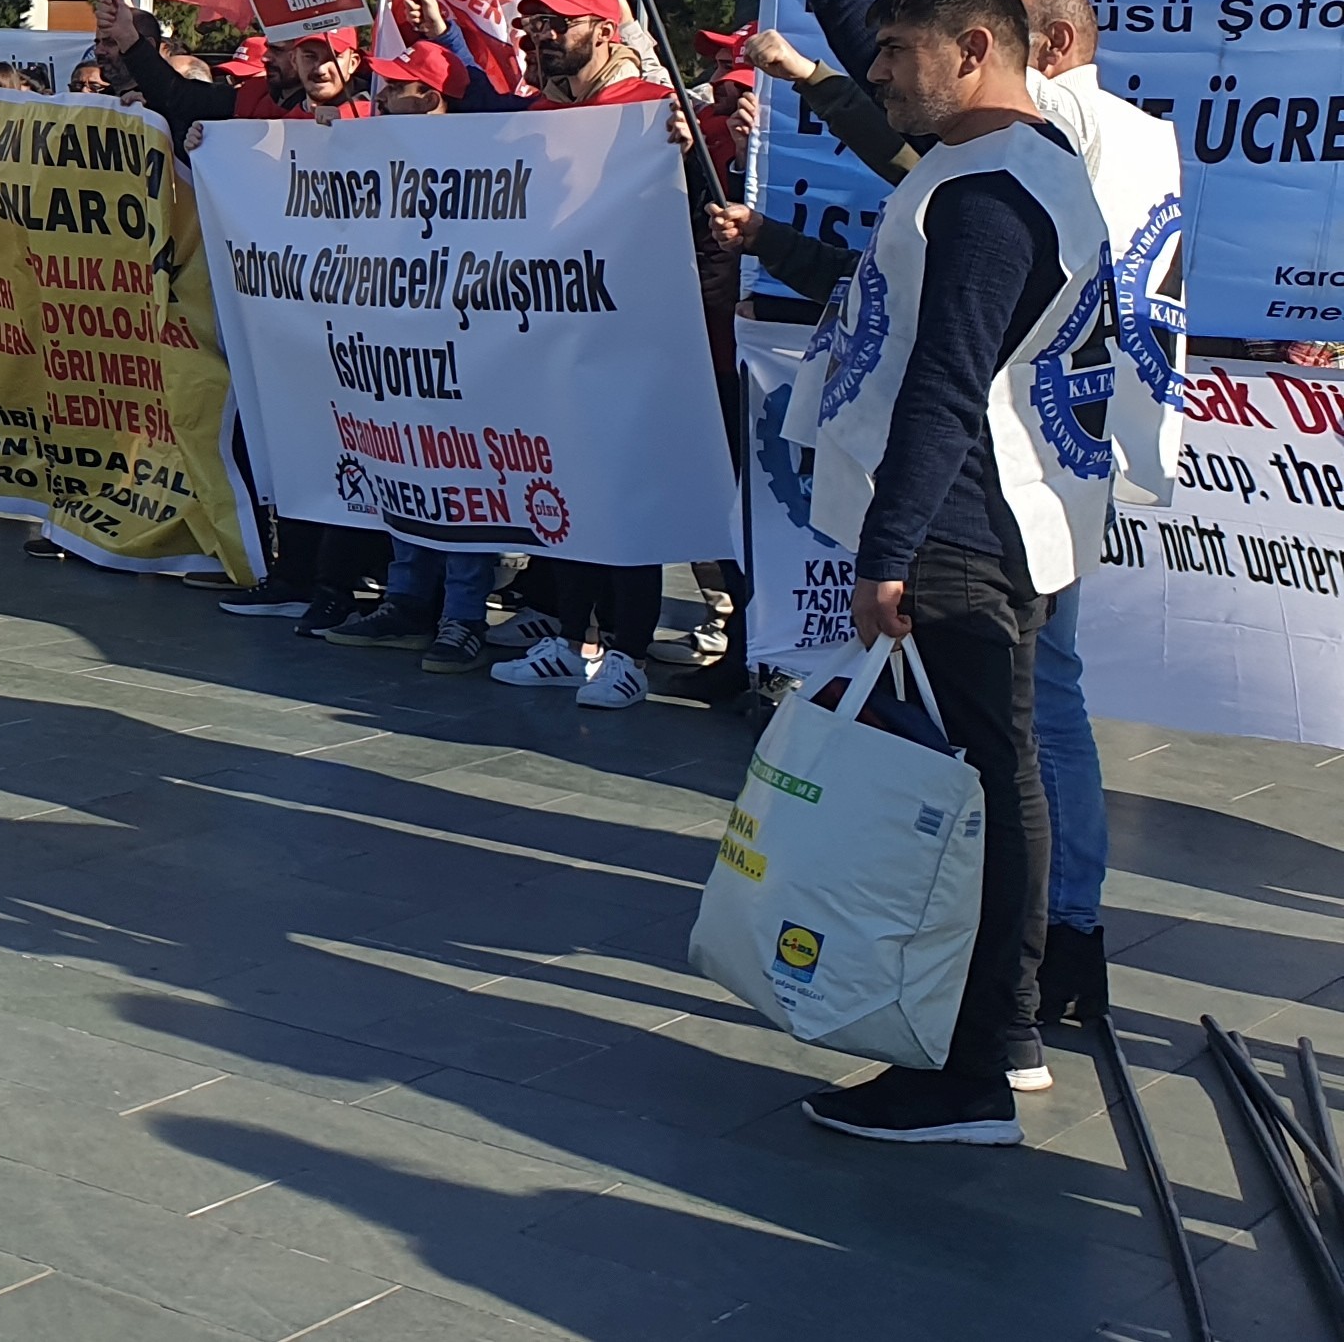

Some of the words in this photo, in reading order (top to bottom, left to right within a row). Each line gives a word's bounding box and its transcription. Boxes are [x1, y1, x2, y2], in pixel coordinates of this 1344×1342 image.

[284, 149, 382, 220] İnsanca
[389, 158, 533, 239] Yaşamak
[312, 243, 450, 312] Güvenceli
[452, 248, 618, 333] Çalışmak
[325, 319, 462, 402] İstiyoruz!
[1119, 291, 1164, 386] KARAYOLU
[329, 400, 405, 466] İstanbul
[419, 421, 483, 471] Nolu
[482, 425, 553, 486] Şube
[1158, 515, 1236, 578] nicht
